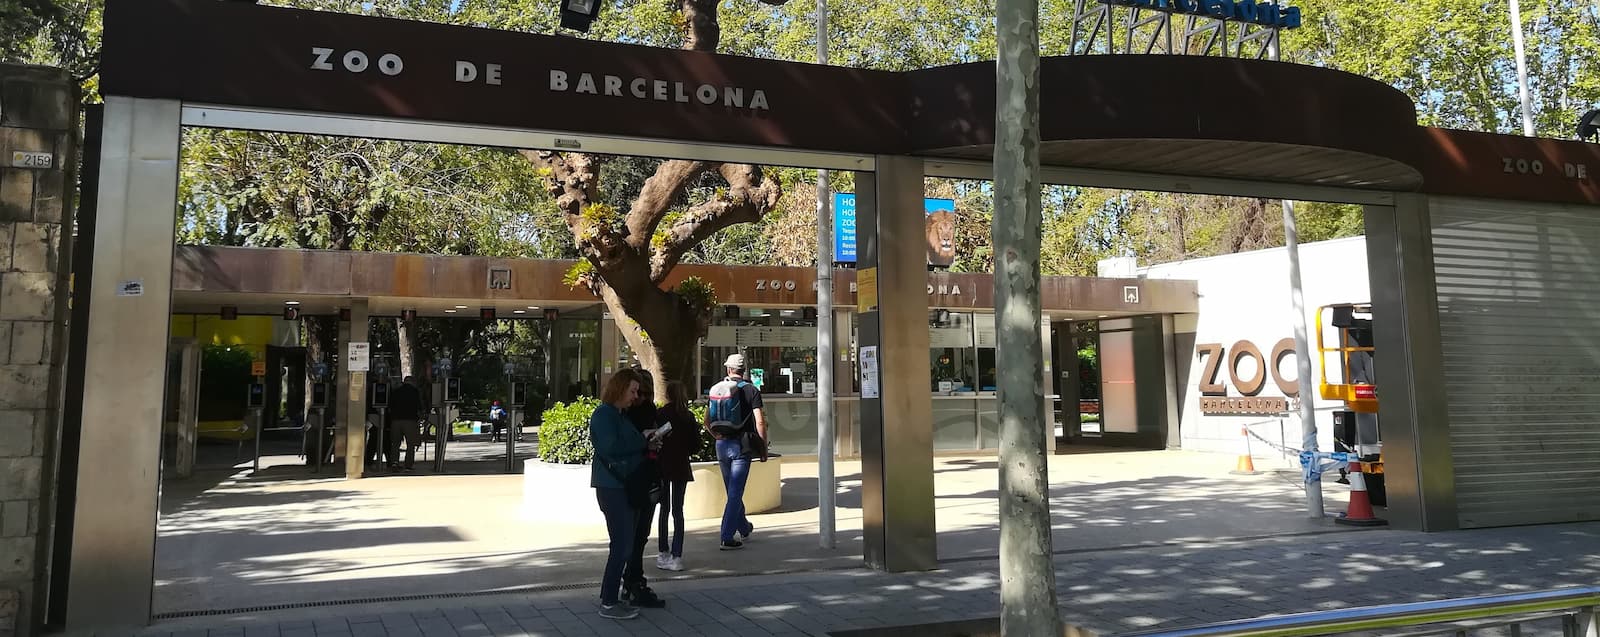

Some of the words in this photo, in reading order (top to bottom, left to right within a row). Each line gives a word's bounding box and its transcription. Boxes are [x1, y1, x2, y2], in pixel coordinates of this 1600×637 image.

[310, 47, 404, 76] ZOO
[455, 60, 502, 85] DE
[549, 69, 770, 110] BARCELONA
[24, 154, 51, 166] 2159
[1502, 157, 1544, 175] ZOO
[1564, 163, 1587, 179] DE
[756, 280, 796, 291] ZOO
[1196, 337, 1299, 396] ZOO
[1202, 399, 1283, 411] BARCELONA
